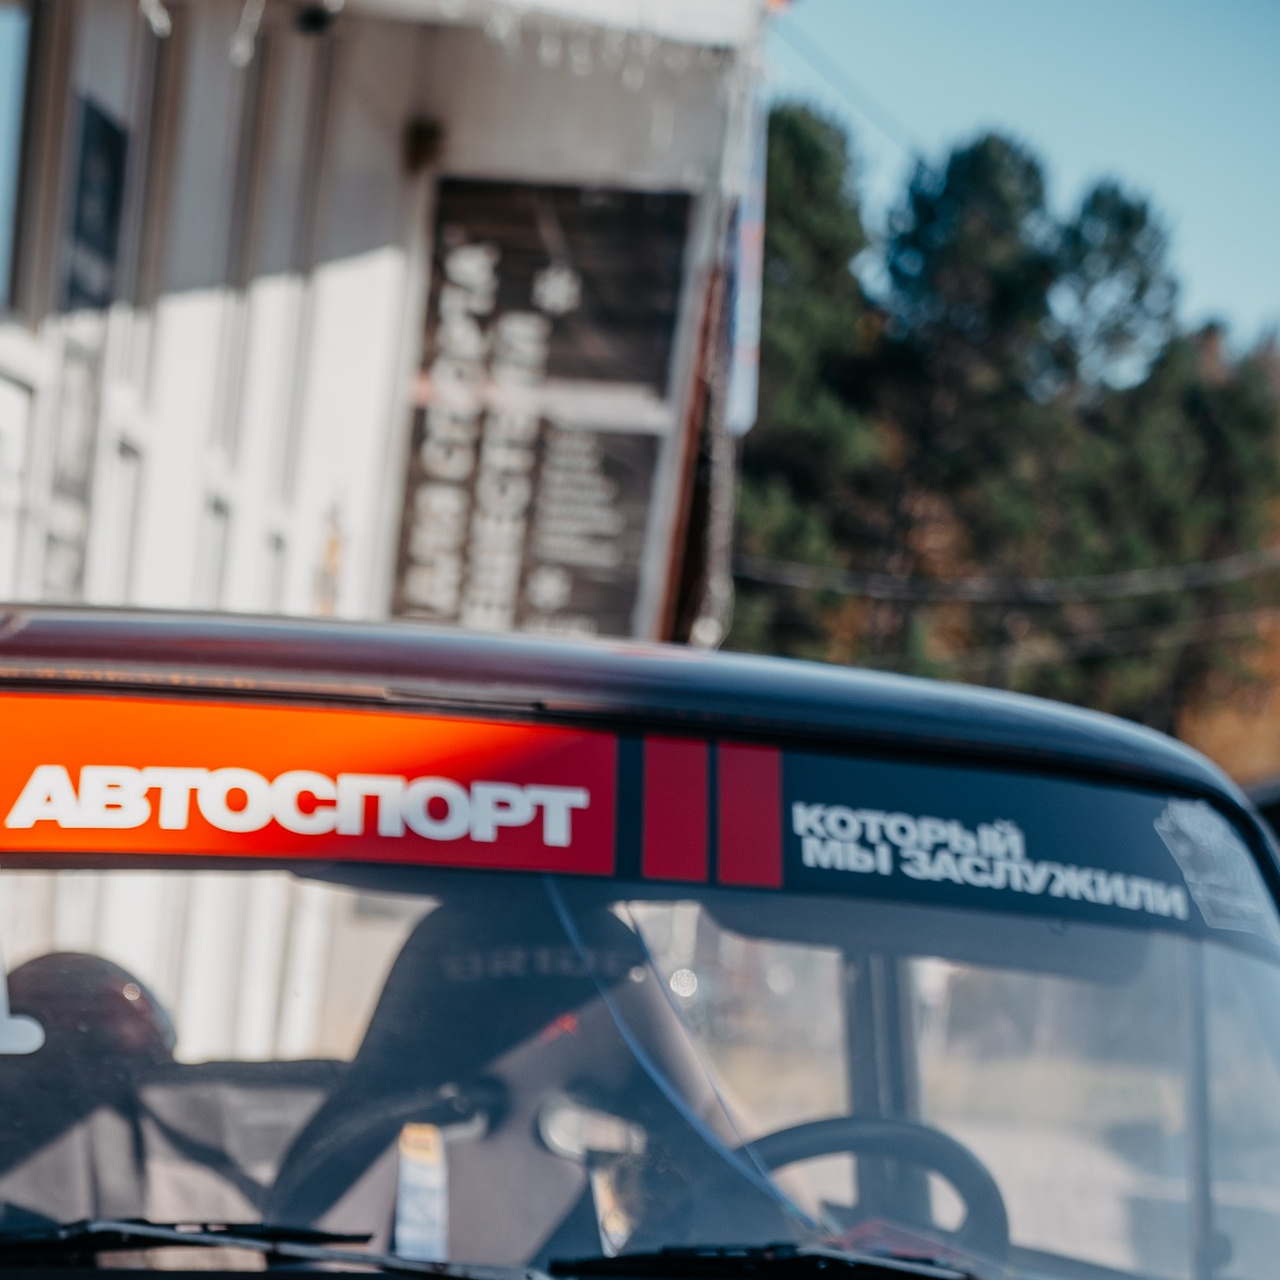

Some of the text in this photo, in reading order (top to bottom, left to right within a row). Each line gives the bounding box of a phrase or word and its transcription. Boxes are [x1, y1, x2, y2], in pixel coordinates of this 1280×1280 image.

[5, 765, 589, 847] АВТОСПОРТ
[791, 800, 1026, 860] КОТОРЫЙ
[801, 837, 1191, 921] МЫ ЗАСЛУЖИЛИ
